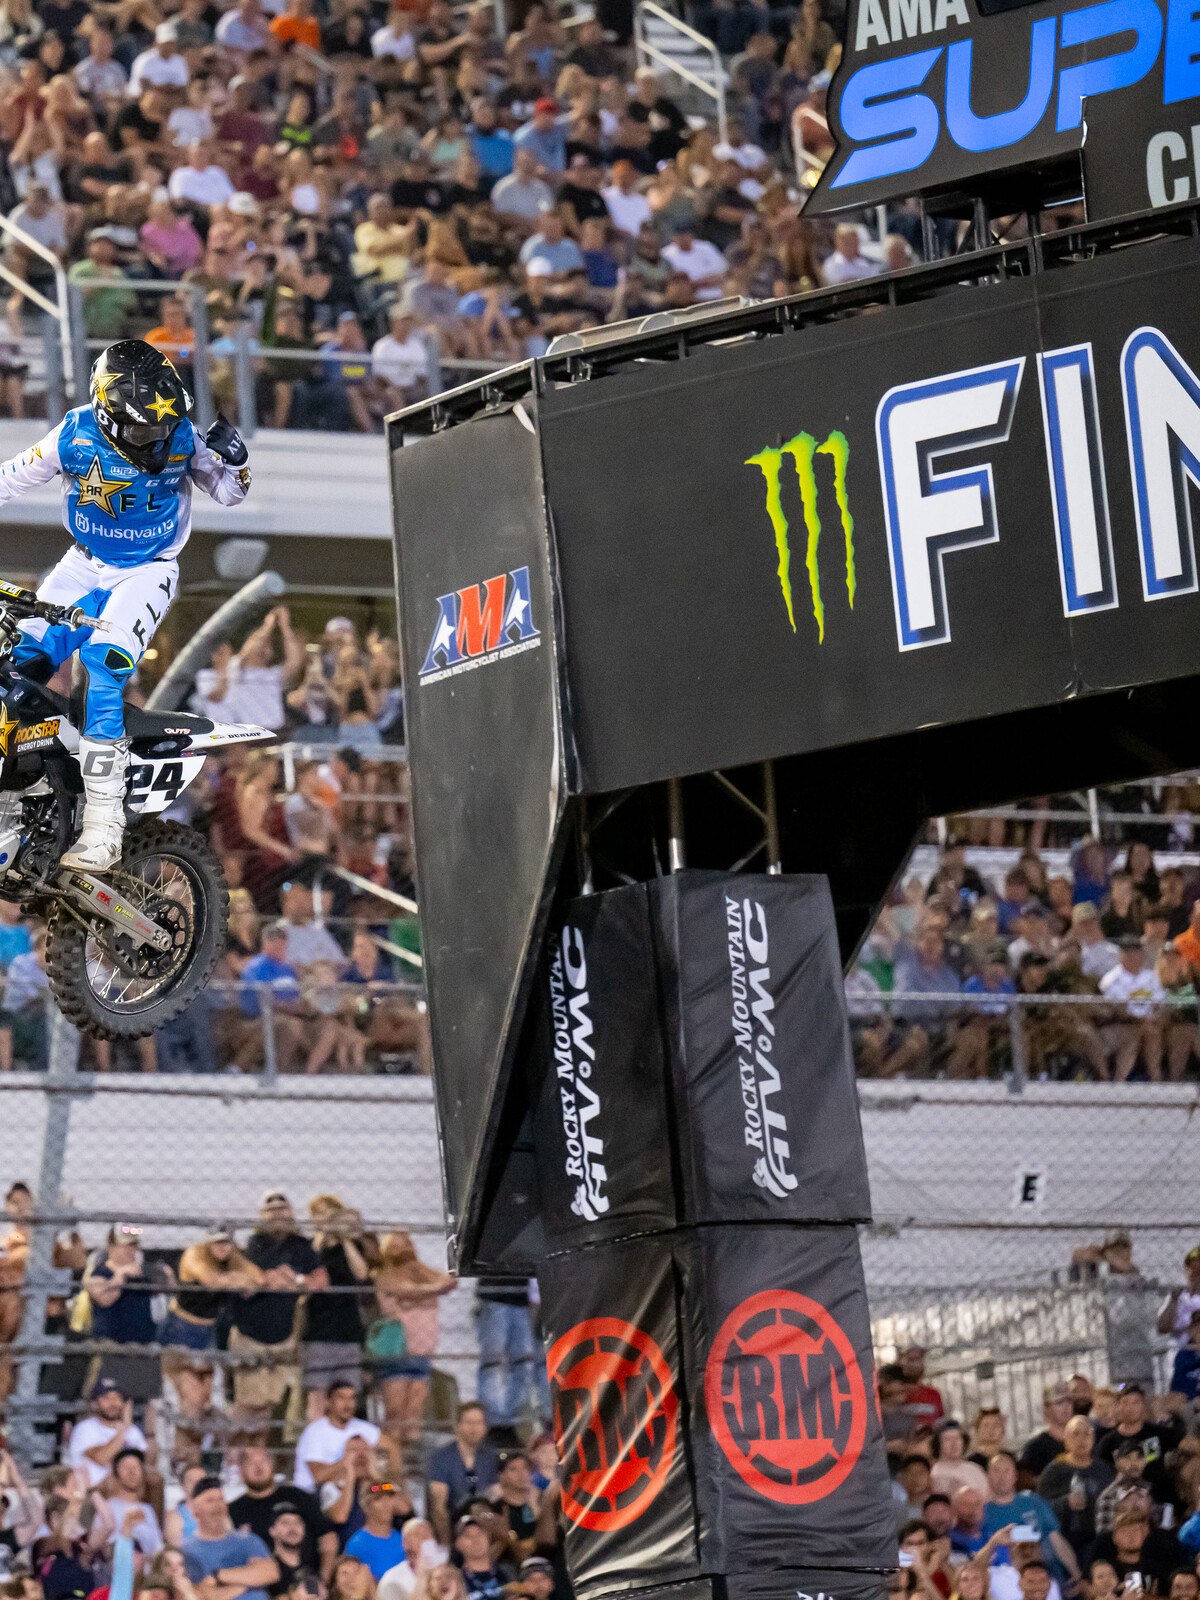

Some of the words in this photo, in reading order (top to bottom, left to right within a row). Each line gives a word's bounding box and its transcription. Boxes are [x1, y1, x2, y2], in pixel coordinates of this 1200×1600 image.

[855, 0, 970, 50] AMA
[1146, 125, 1200, 208] C
[110, 466, 139, 479] WPS
[875, 326, 1200, 652] FIN
[91, 519, 175, 541] Husqvarna
[132, 576, 173, 648] FLY
[418, 566, 541, 675] AMA
[14, 719, 60, 744] ROCKSTAR
[17, 740, 37, 752] ENERGY
[37, 737, 54, 748] DRINK
[227, 731, 262, 739] DUNLOP
[83, 750, 116, 777] G
[124, 761, 186, 804] 24
[96, 890, 113, 907] RK
[725, 895, 753, 1055] MOUNTAIN
[738, 1055, 764, 1152] ROCKY
[560, 1087, 584, 1180] ROCKY
[1021, 1173, 1040, 1202] E
